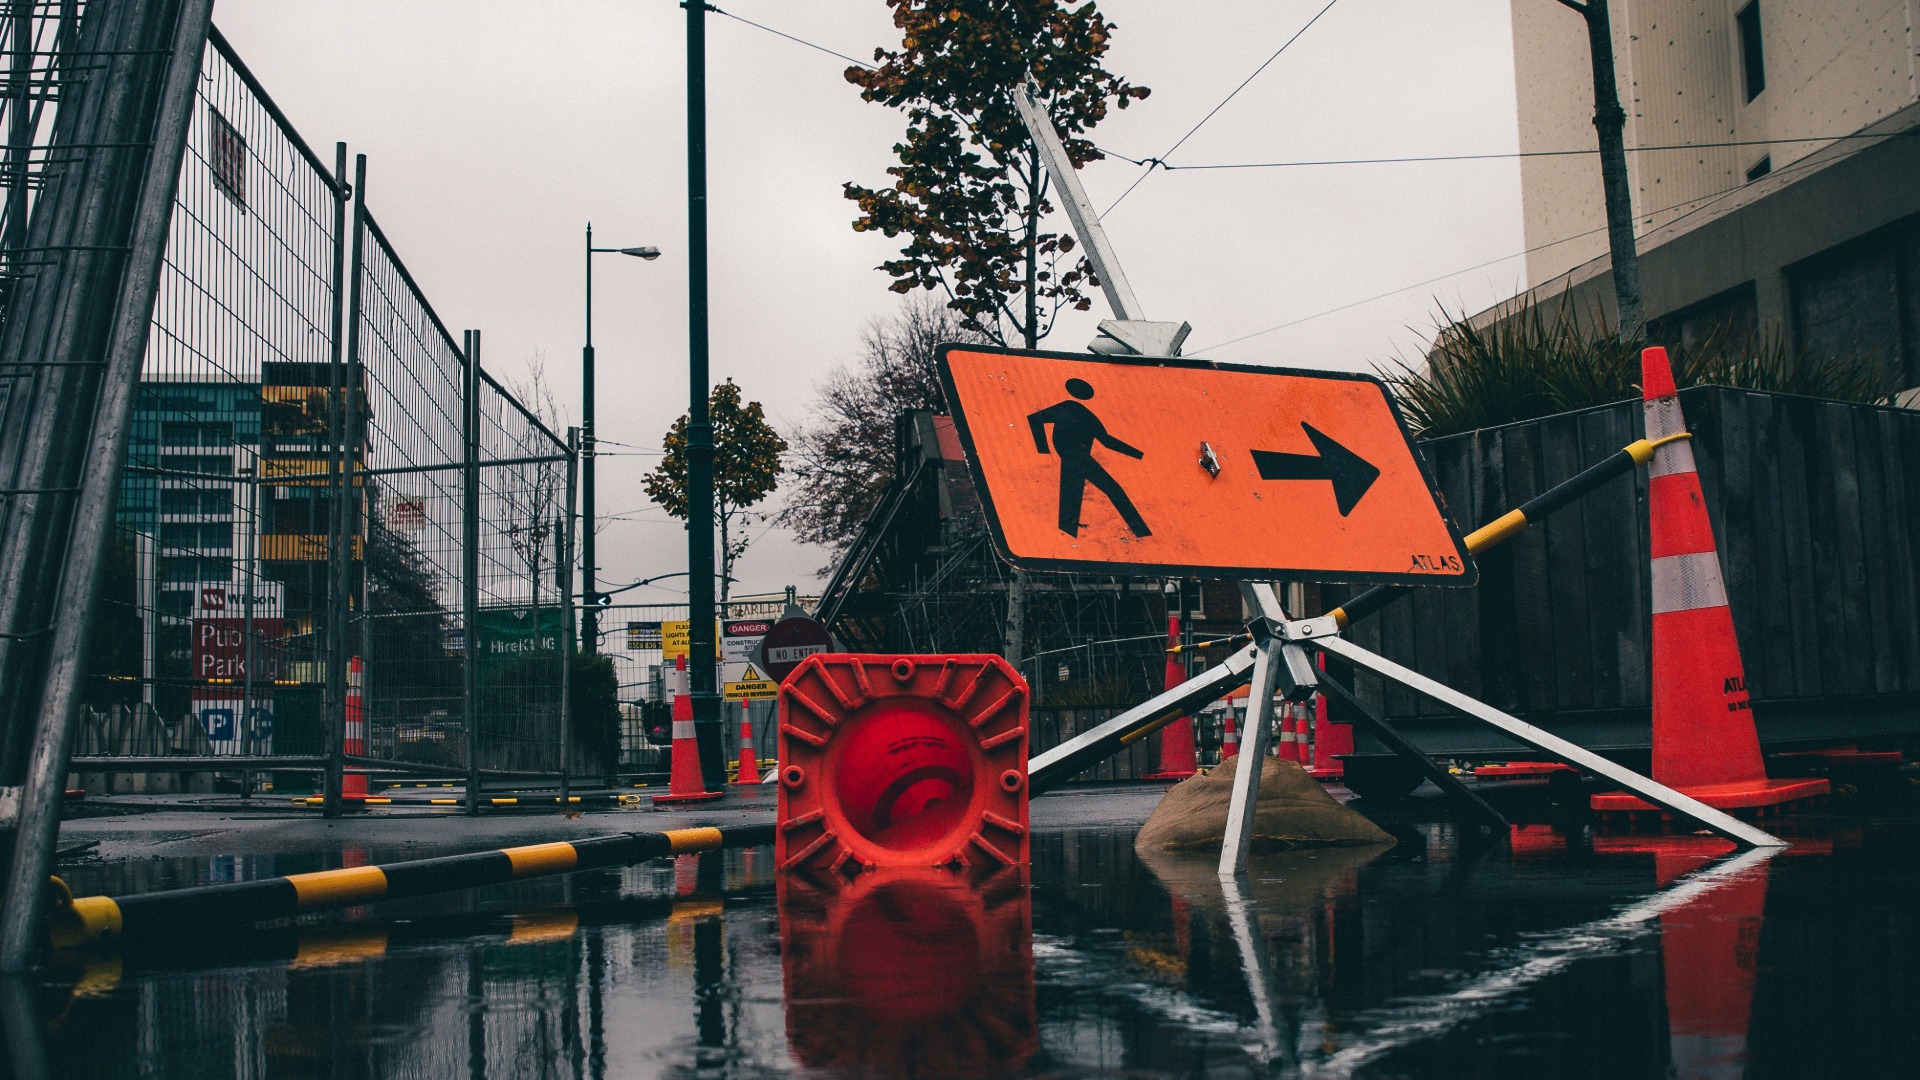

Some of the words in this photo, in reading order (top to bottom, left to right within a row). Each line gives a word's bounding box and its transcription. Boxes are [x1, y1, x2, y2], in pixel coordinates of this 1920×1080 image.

[1411, 554, 1461, 571] ATLAS
[227, 594, 276, 605] Wison
[731, 624, 766, 632] DANGER
[776, 650, 788, 660] NO
